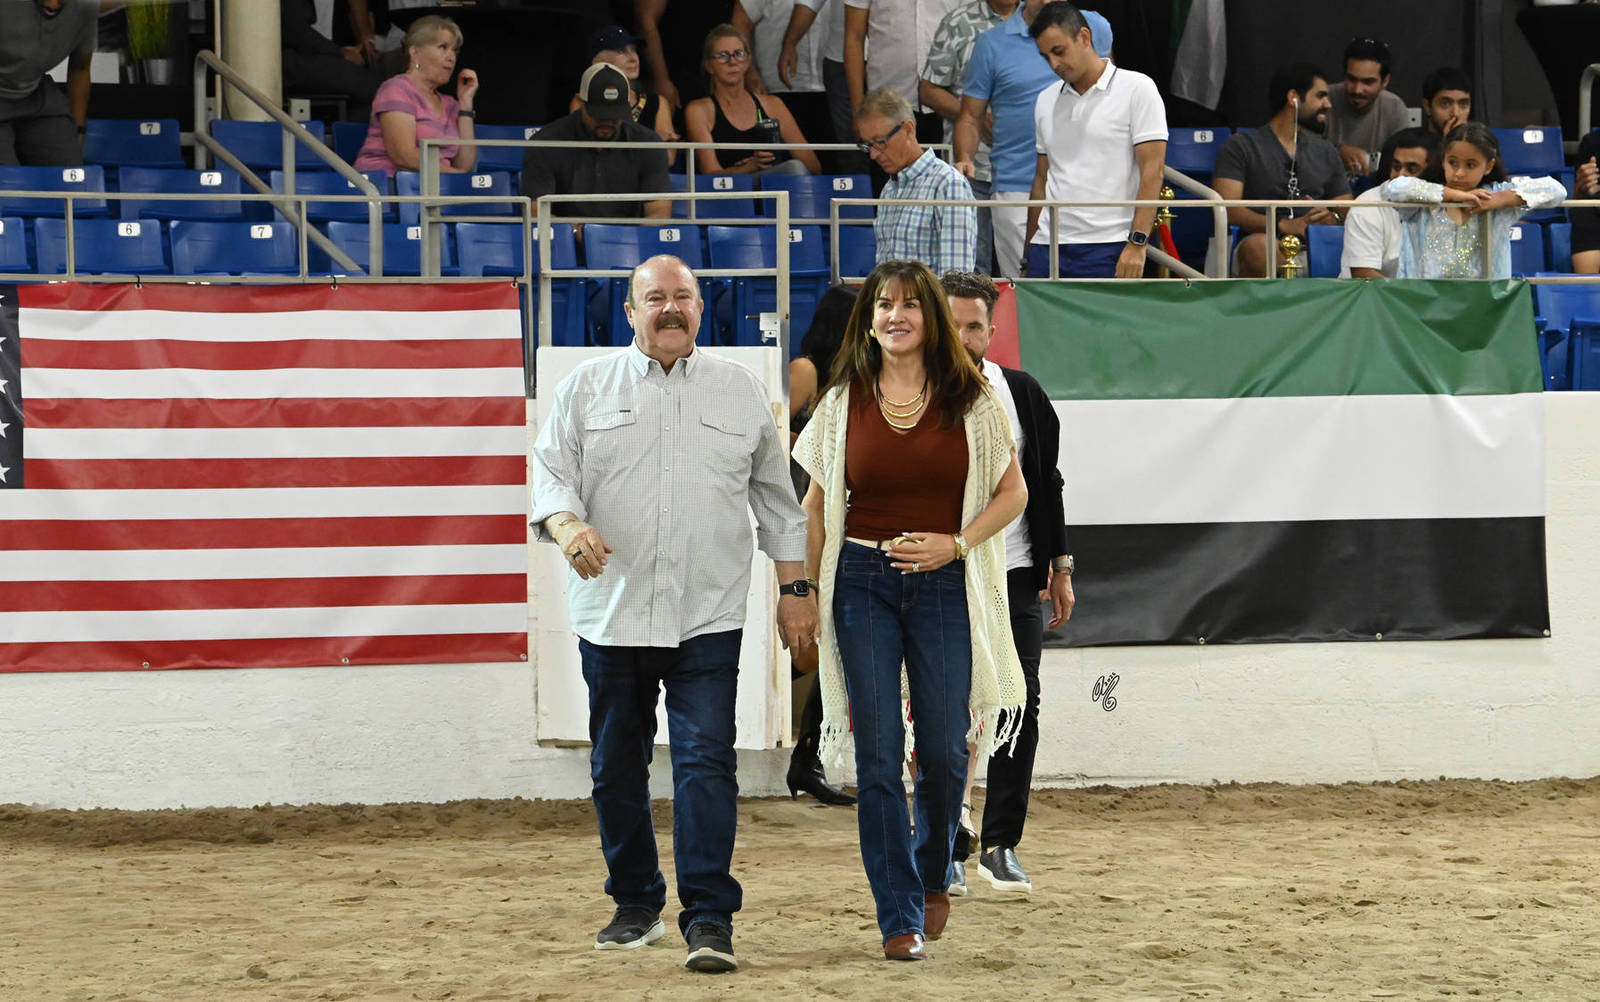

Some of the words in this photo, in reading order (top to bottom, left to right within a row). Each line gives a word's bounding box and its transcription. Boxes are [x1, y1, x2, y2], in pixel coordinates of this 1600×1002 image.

[146, 123, 153, 134] 7
[70, 169, 77, 181] 6
[207, 174, 213, 184] 7
[479, 176, 485, 186] 2
[720, 178, 726, 188] 4
[840, 179, 846, 190] 5
[126, 223, 132, 235] 6
[258, 226, 264, 237] 7
[415, 228, 420, 239] 1
[666, 230, 673, 241] 3
[789, 231, 795, 241] 4
